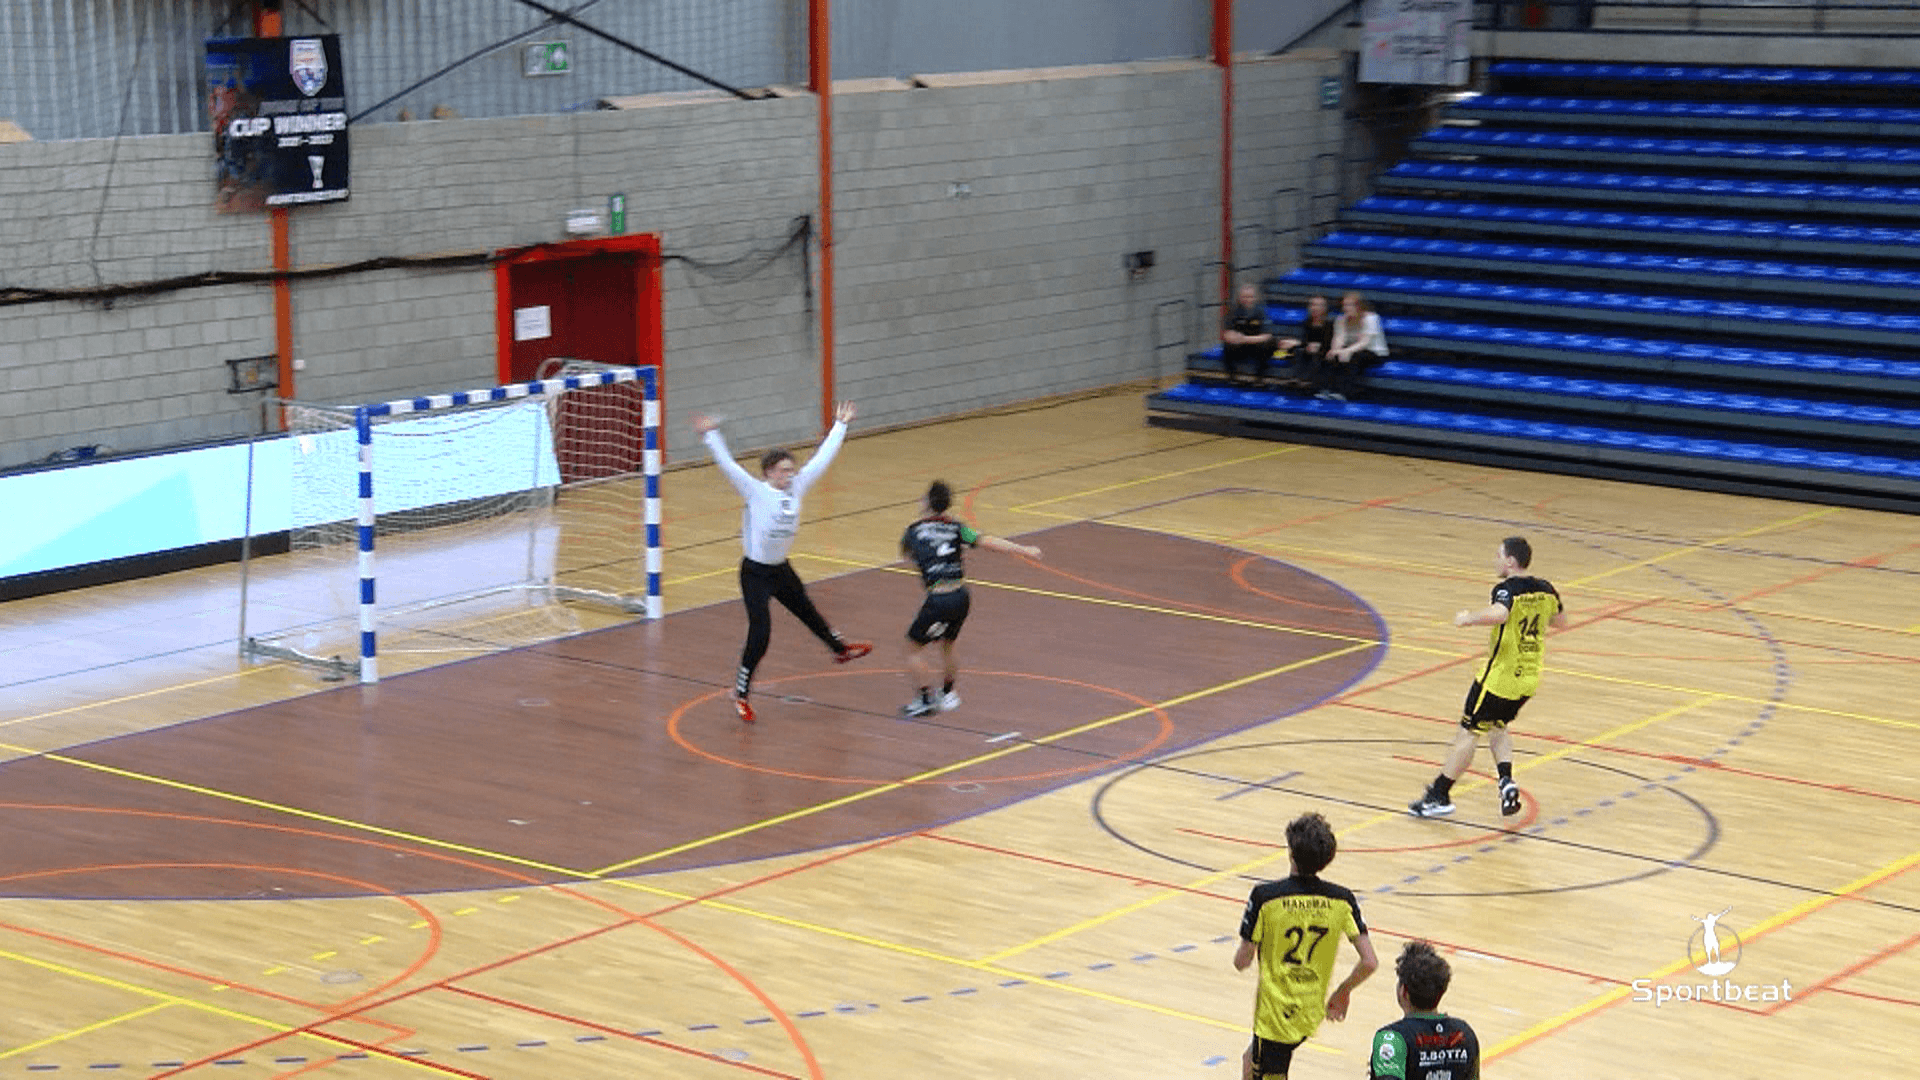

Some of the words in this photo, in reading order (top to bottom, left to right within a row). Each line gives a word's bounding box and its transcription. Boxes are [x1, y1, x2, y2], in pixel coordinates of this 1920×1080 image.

[229, 117, 272, 138] CUP
[273, 112, 348, 135] WINNER
[1518, 612, 1541, 640] 14
[1282, 925, 1329, 965] 27
